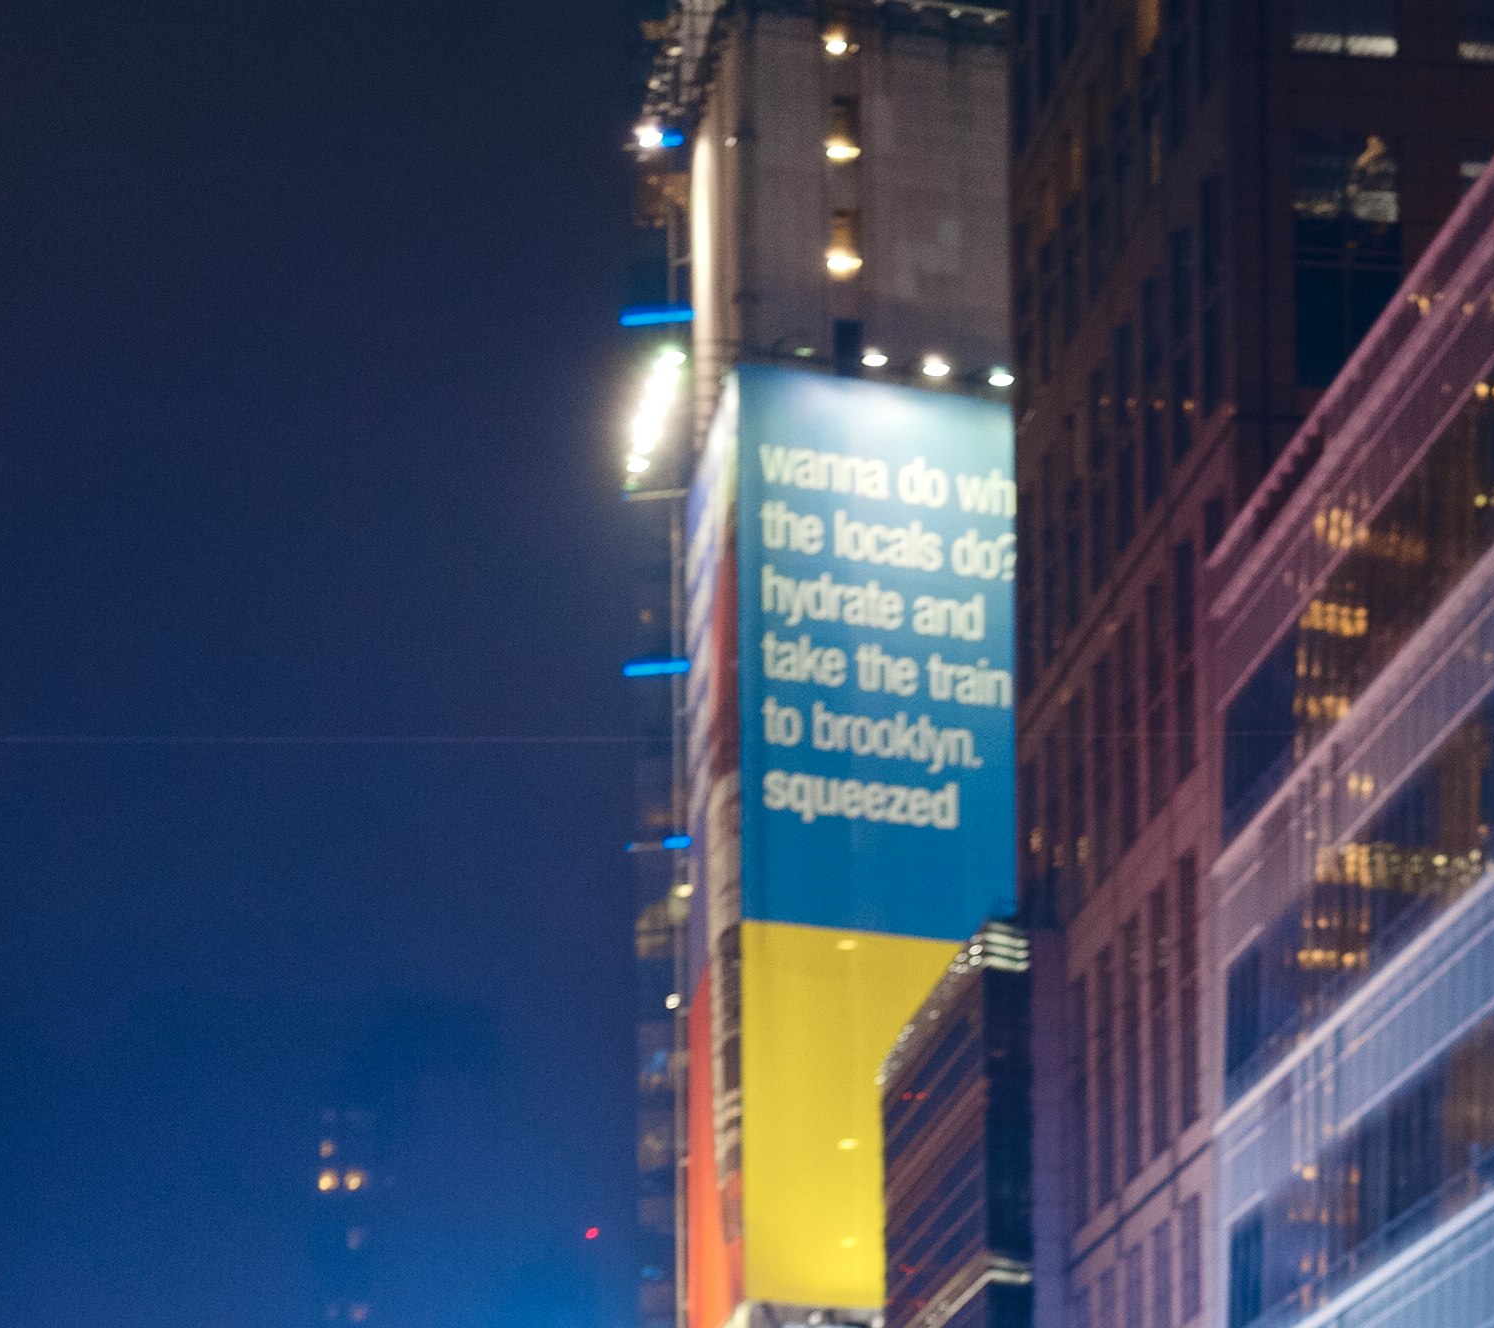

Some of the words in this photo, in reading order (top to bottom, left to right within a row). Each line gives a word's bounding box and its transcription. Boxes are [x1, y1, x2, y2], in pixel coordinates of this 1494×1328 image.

[759, 440, 890, 501] wanna
[898, 456, 949, 507] do
[761, 501, 825, 555] the
[833, 511, 944, 573] locals
[950, 528, 1017, 582] do?
[762, 564, 904, 640] hydrate
[912, 593, 985, 640] and
[762, 632, 847, 688] take
[855, 643, 919, 698] the
[927, 651, 1015, 709] train
[762, 697, 803, 747] to
[762, 769, 960, 830] squeezed
